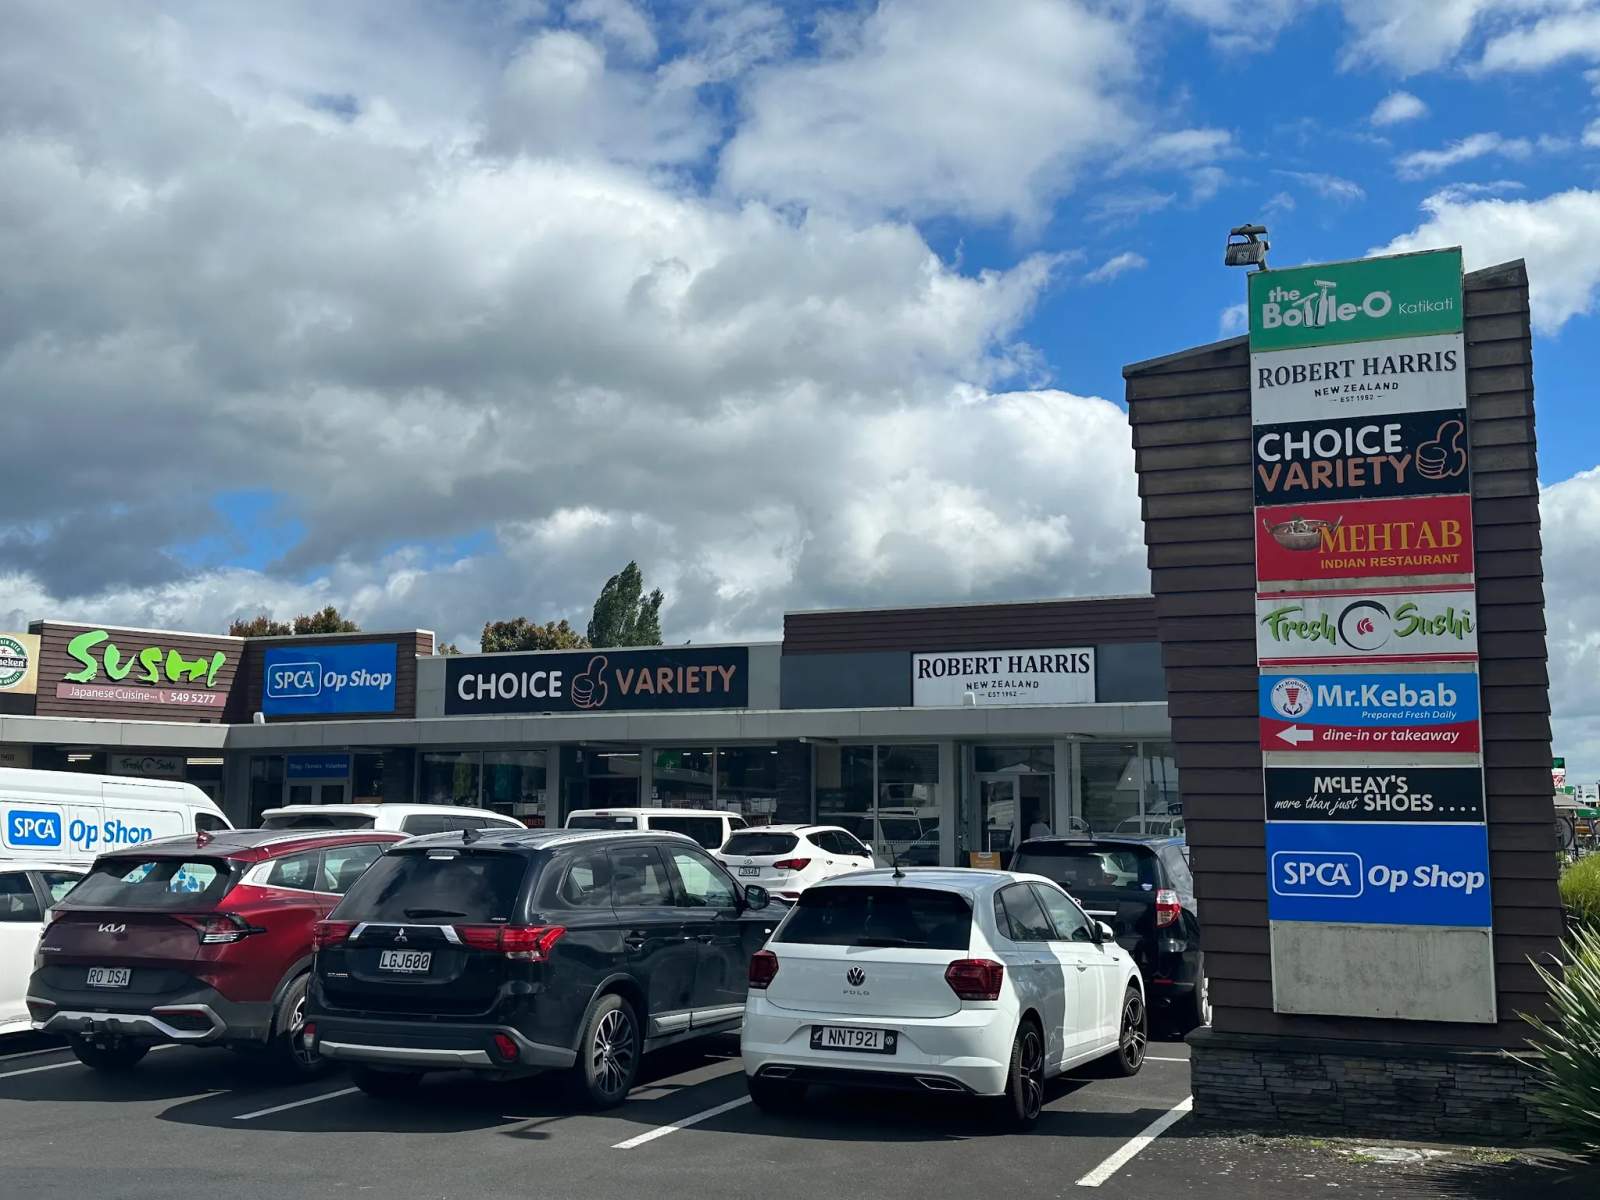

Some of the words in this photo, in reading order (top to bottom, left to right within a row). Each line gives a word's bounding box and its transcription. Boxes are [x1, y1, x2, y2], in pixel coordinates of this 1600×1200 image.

[1268, 286, 1301, 303] the
[1398, 298, 1453, 314] Katikati
[1258, 359, 1355, 389] ROBERT
[1362, 350, 1457, 376] HARRIS
[1314, 385, 1340, 397] NEW
[1343, 382, 1399, 393] ZEALAND
[1257, 423, 1402, 462] CHOICE
[1257, 453, 1412, 492] VARIETY
[1318, 519, 1463, 554] MEHTAB
[1320, 557, 1366, 569] INDIAN
[1370, 554, 1460, 567] RESTAURANT
[1260, 605, 1337, 645] Fresh
[1393, 602, 1475, 640] Sushi
[917, 656, 1002, 679] ROBERT
[1007, 653, 1091, 674] HARRIS
[274, 670, 315, 689] SPCA
[324, 671, 347, 692] Op
[349, 669, 392, 690] Shop
[457, 670, 563, 701] CHOICE
[615, 664, 737, 696] VARIETY
[966, 680, 989, 691] NEW
[991, 680, 1039, 689] ZEALAND
[70, 686, 114, 699] Japanese
[170, 692, 190, 702] 549
[191, 693, 216, 703] 5277
[1317, 682, 1457, 708] Mr.Kebab
[1361, 710, 1404, 720] Prepared
[1405, 710, 1430, 719] Fresh
[1432, 710, 1457, 720] Daily
[1322, 729, 1370, 741] dine-in
[1373, 731, 1389, 741] or
[1391, 729, 1460, 744] takeaway
[1274, 799, 1301, 809] more
[1305, 794, 1329, 809] than
[1328, 796, 1359, 816] just
[14, 818, 56, 839] SPCA
[69, 819, 98, 850] Op
[1283, 861, 1352, 886] SPCA
[1367, 865, 1409, 893] Op
[1412, 864, 1485, 894] Shop
[380, 952, 430, 969] LGJ600
[107, 969, 127, 984] DSA
[829, 1029, 877, 1048] NNT921
